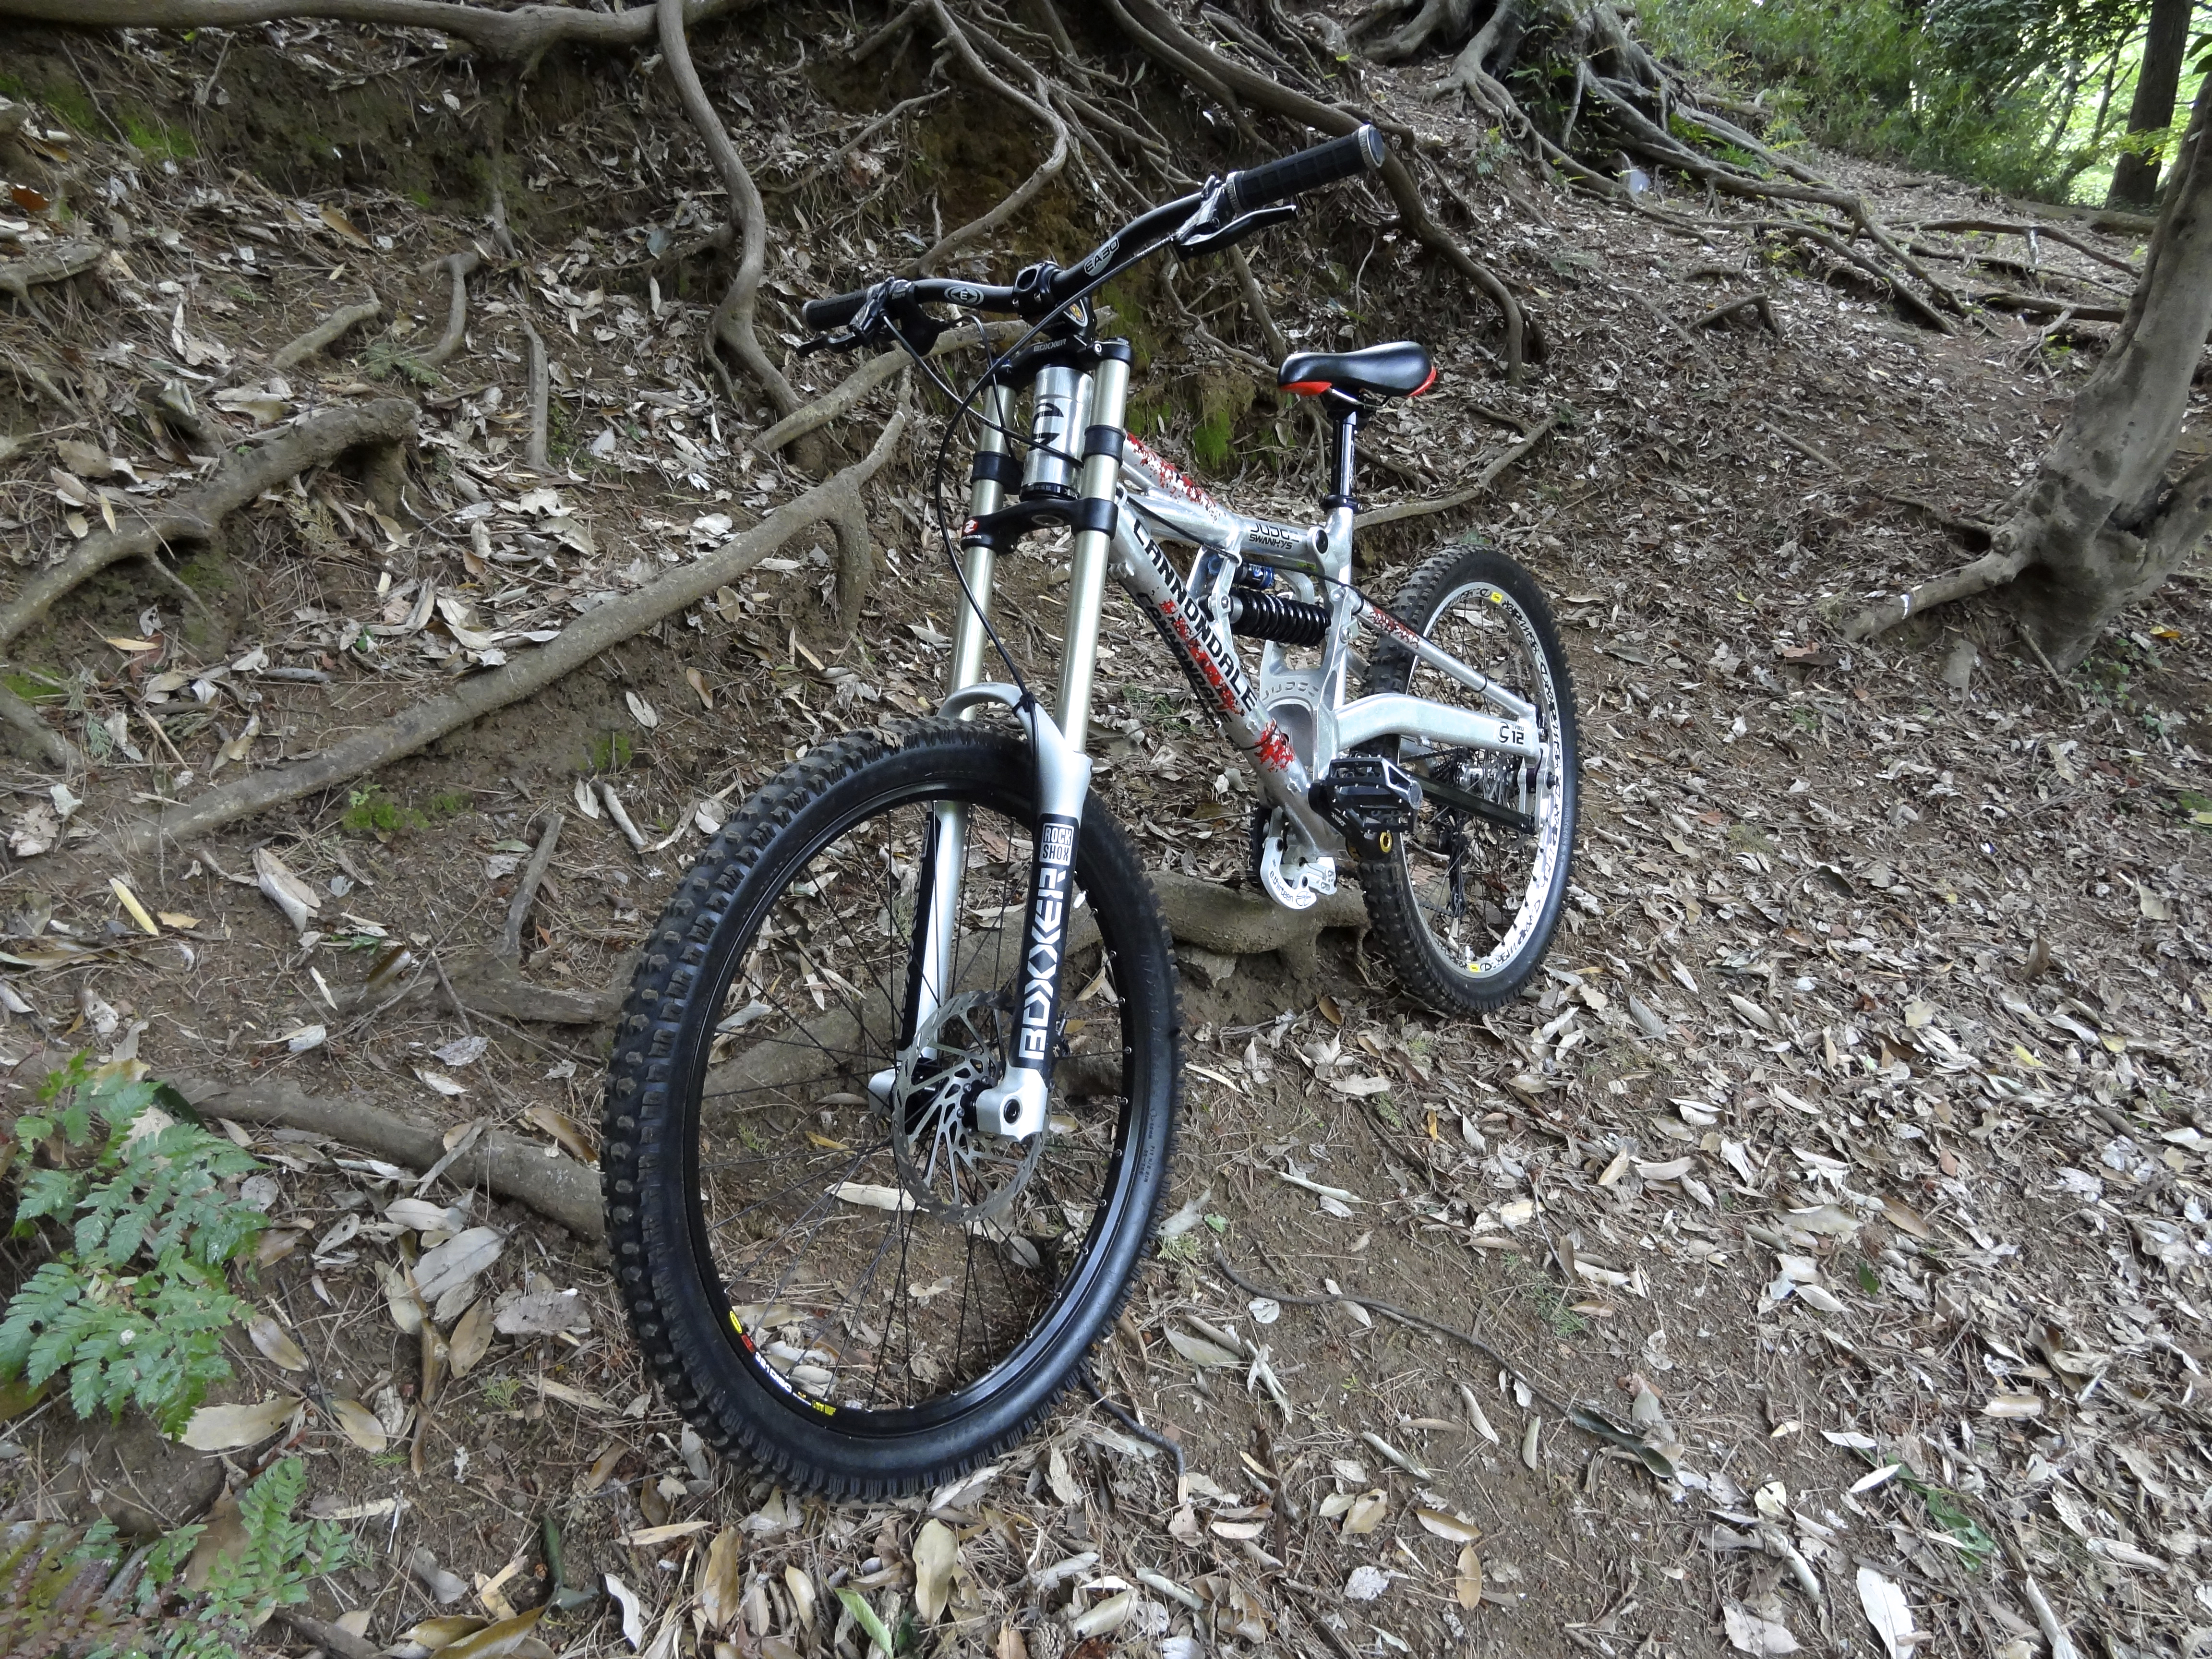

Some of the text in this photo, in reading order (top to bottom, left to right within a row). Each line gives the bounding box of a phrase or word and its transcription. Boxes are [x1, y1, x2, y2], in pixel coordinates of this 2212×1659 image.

[1085, 239, 1119, 273] EA30
[1250, 523, 1299, 543] JUDGE
[1133, 518, 1257, 712] CANNONDALE
[1511, 730, 1525, 745] 12
[1044, 827, 1072, 845] ROCK
[1042, 844, 1070, 862] SHOX
[1269, 870, 1294, 903] e.thirteen
[1019, 867, 1067, 1060] BOXXER
